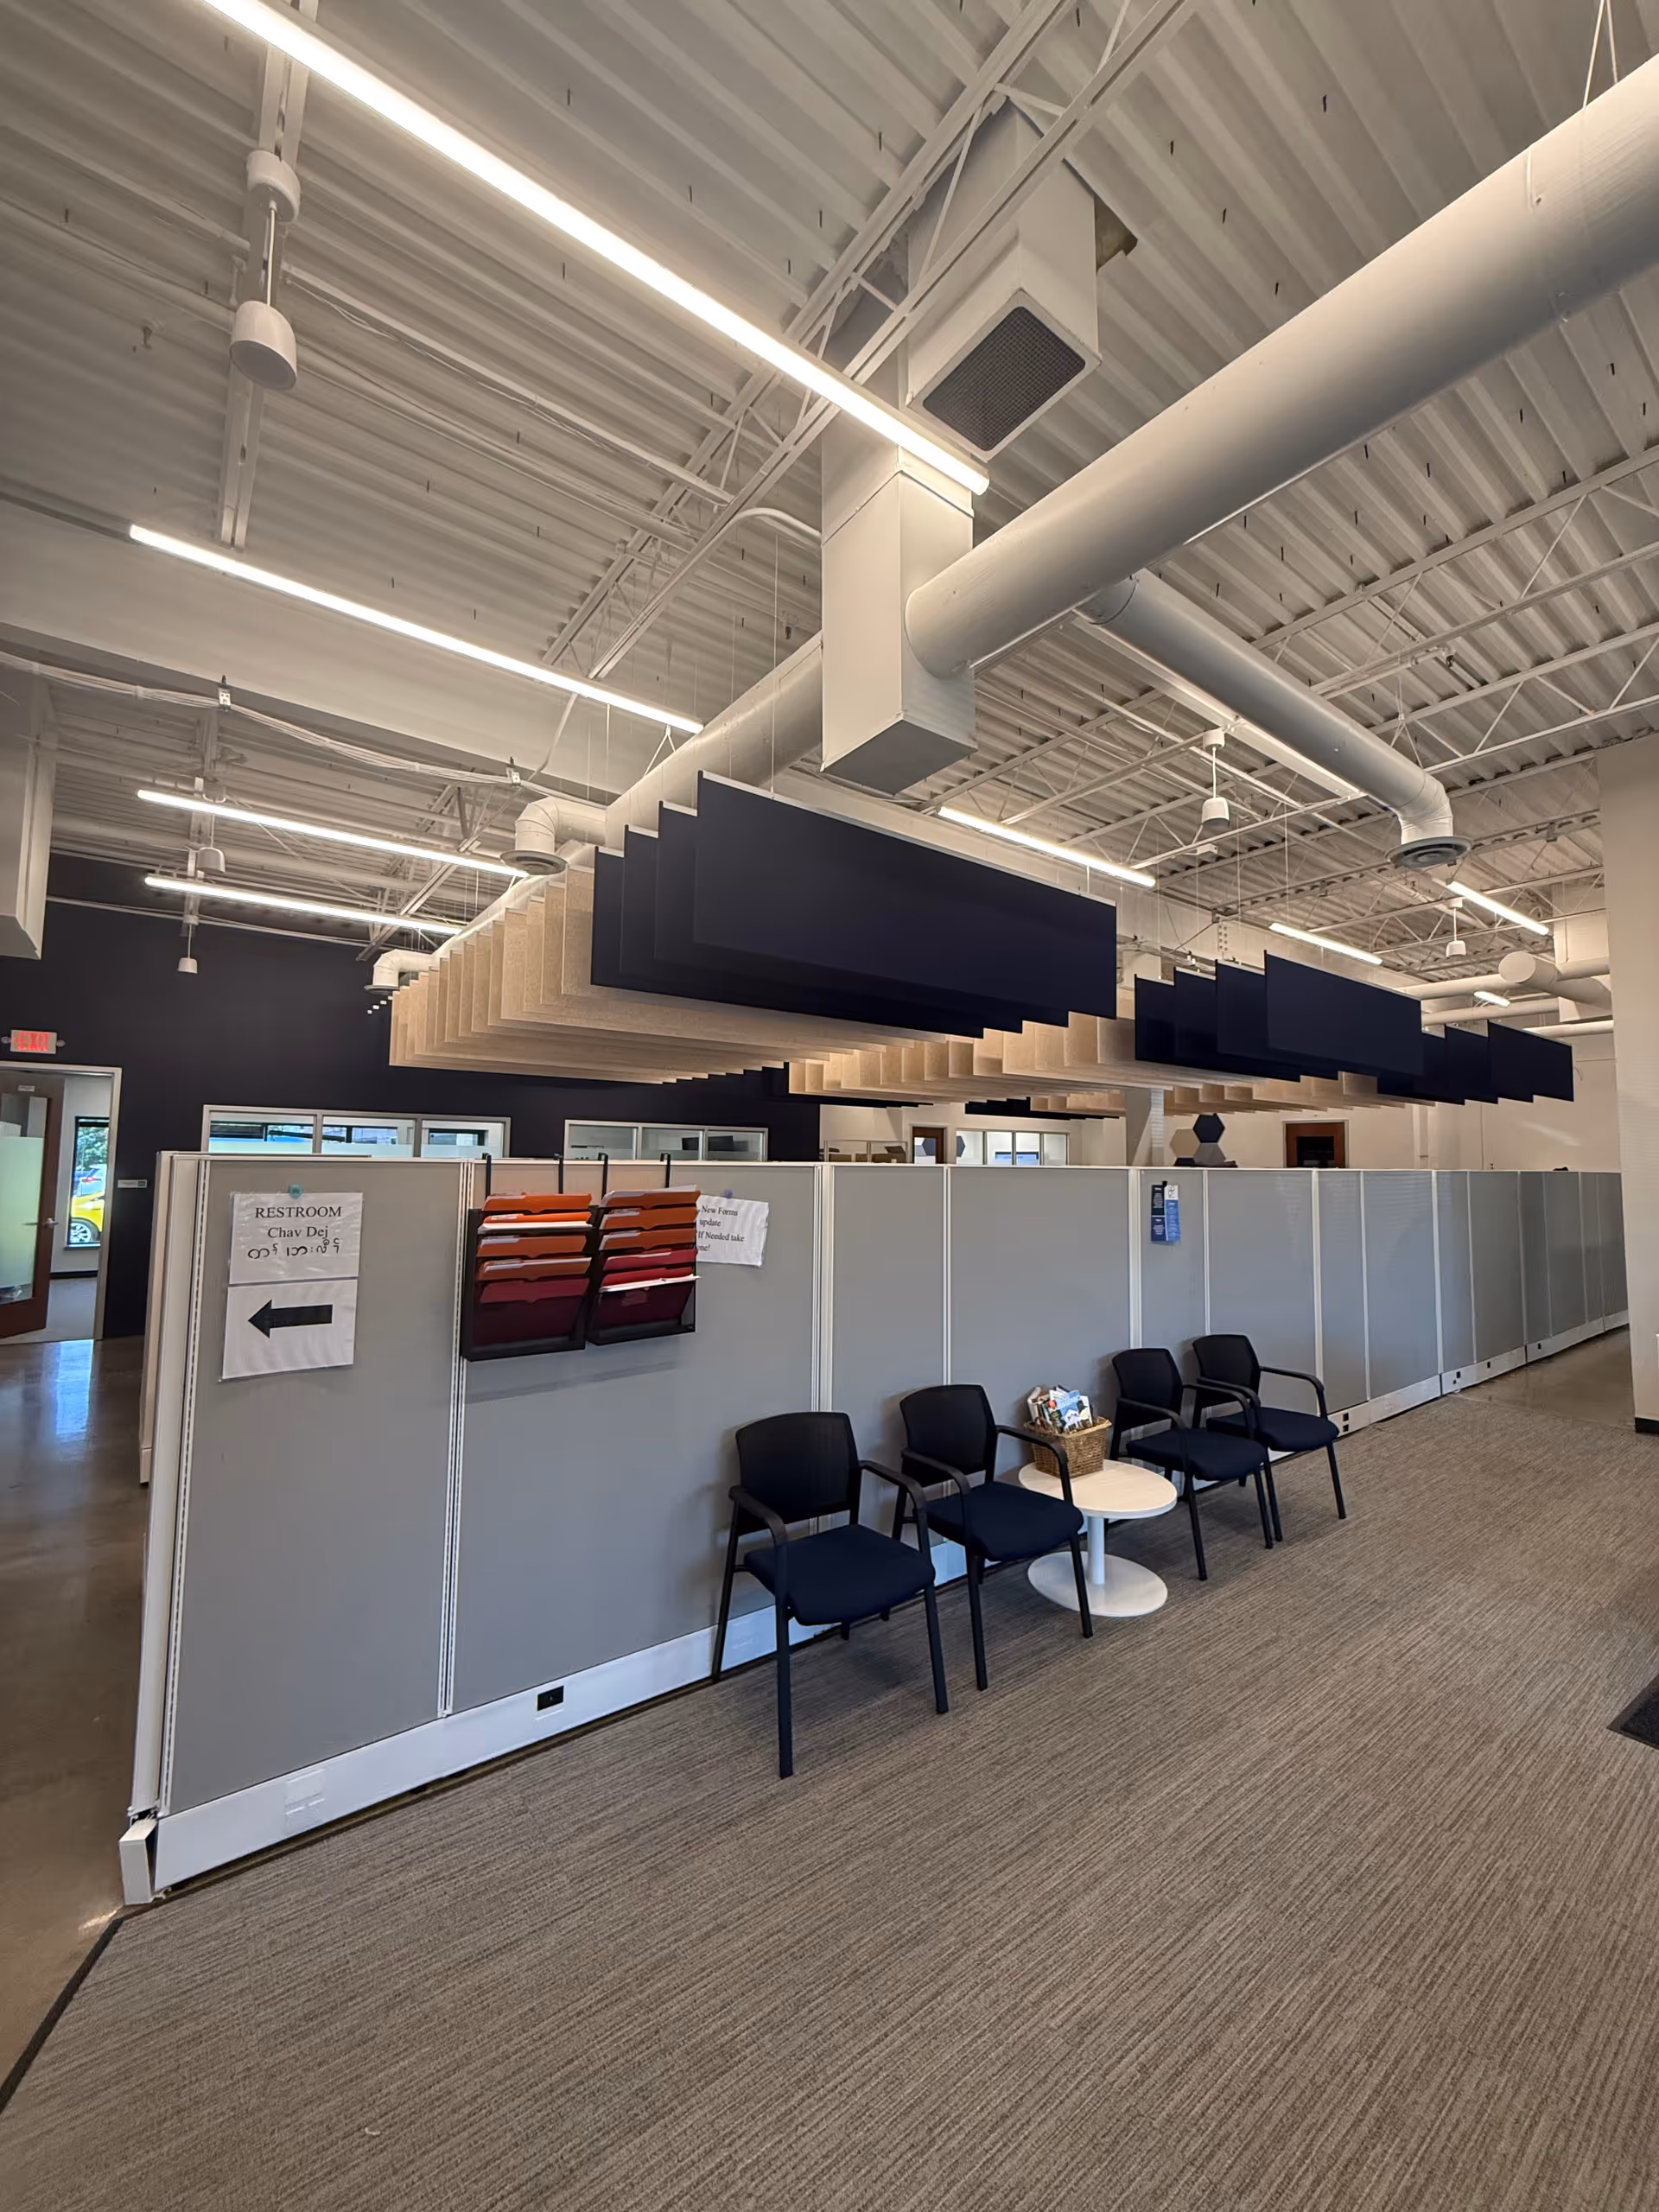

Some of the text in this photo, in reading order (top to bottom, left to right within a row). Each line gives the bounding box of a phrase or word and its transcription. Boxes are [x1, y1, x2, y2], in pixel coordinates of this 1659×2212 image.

[18, 1032, 49, 1052] EXIT
[255, 1206, 342, 1218] RESTROOM
[718, 1207, 739, 1217] Forms
[699, 1218, 721, 1227] update
[267, 1226, 328, 1238] Chav Dej
[705, 1231, 730, 1241] Needed
[730, 1234, 745, 1243] take
